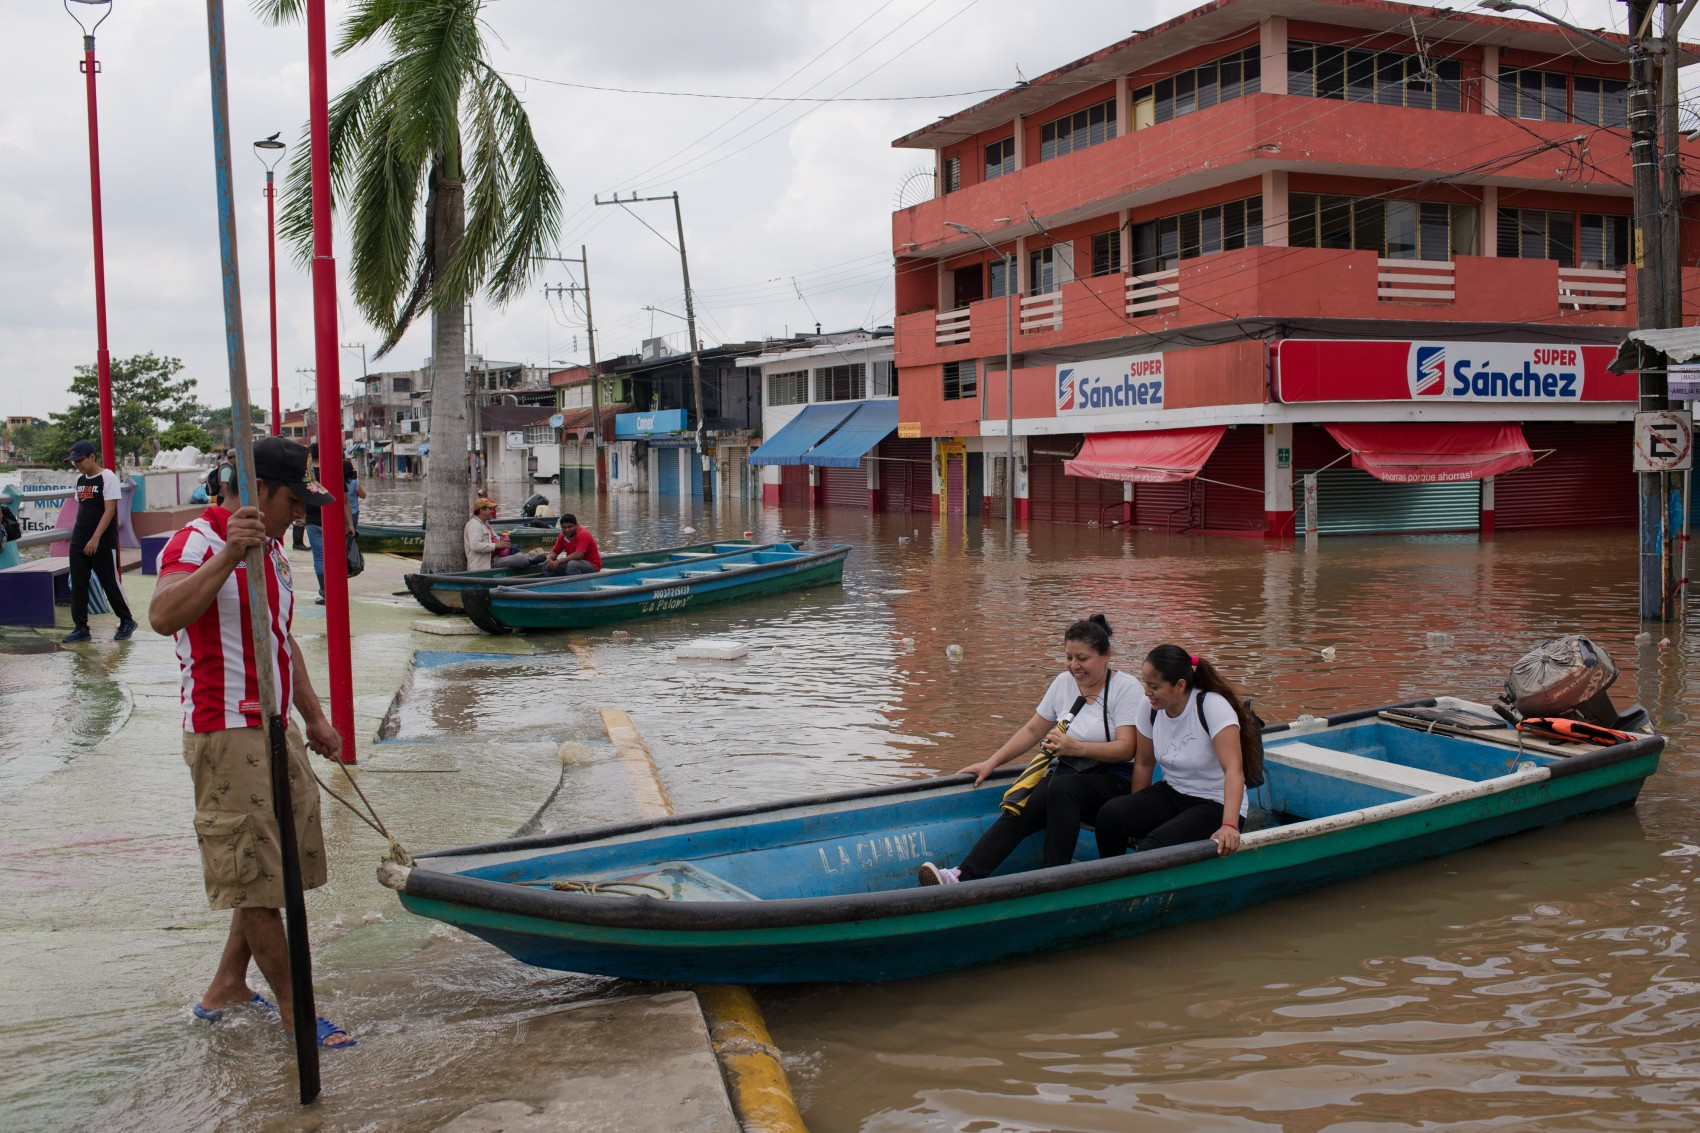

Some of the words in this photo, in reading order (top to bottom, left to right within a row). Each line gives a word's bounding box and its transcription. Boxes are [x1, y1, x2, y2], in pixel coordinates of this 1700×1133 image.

[1533, 348, 1577, 366] SUPER
[1130, 359, 1162, 377] SUPER
[1453, 360, 1577, 397] Sánchez
[1079, 374, 1163, 409] Sánchez
[1672, 387, 1695, 396] AMELIA
[636, 415, 656, 430] Comex
[1408, 474, 1436, 484] porque
[1438, 470, 1473, 481] ahorras!
[818, 845, 853, 875] LA
[856, 831, 934, 869] CHANEL
